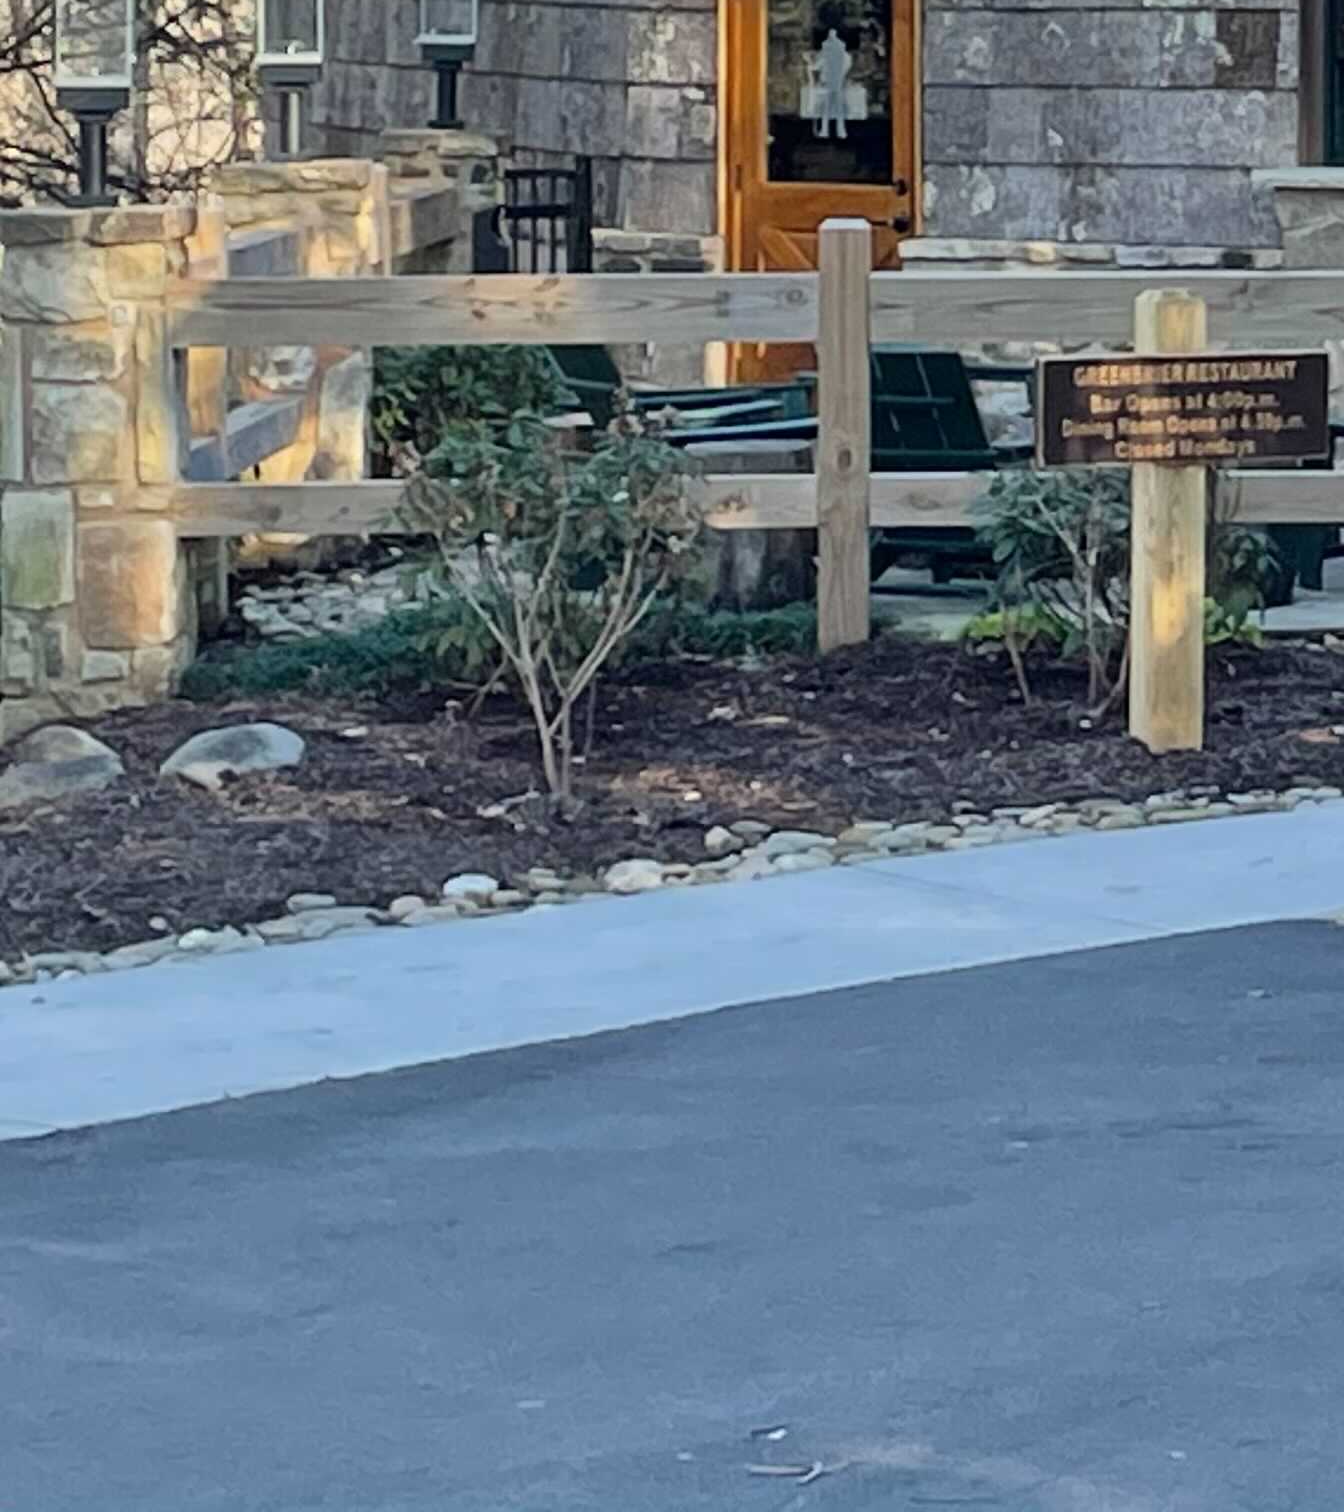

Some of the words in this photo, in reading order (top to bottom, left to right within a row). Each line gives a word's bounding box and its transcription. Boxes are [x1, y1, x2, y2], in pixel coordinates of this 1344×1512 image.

[1186, 360, 1297, 383] RESTAURANT
[1089, 393, 1121, 414] Bar
[1125, 393, 1181, 416] Opens
[1185, 393, 1203, 409] at
[1061, 417, 1114, 440] Dining
[1117, 417, 1164, 435] Room
[1166, 415, 1216, 435] Opens
[1220, 414, 1237, 430] at
[1114, 439, 1176, 458] Closed
